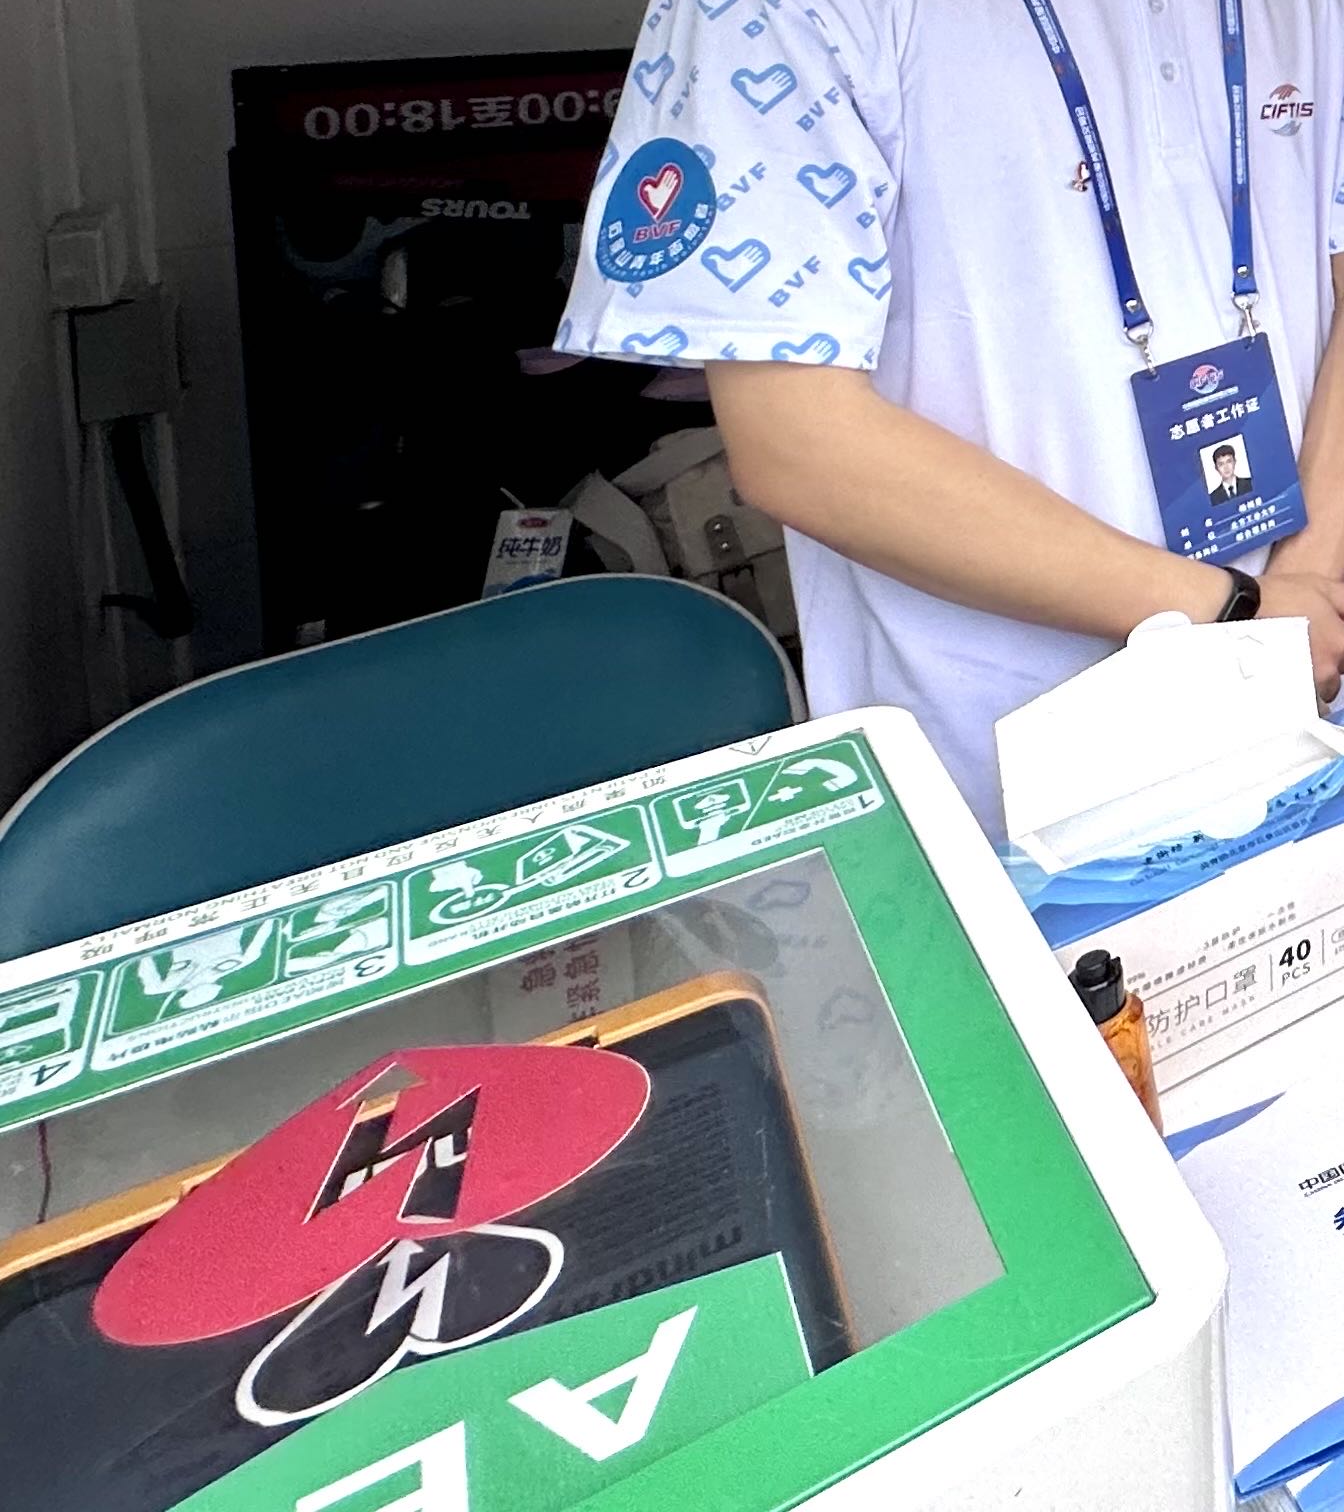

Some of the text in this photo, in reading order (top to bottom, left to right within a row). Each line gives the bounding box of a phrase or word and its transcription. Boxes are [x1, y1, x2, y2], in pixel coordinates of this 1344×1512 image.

[796, 86, 841, 133] BVF
[1260, 101, 1314, 122] CIFTIS
[717, 161, 769, 212] BVF
[420, 198, 531, 220] TOURS
[632, 219, 683, 244] BVF
[768, 255, 823, 308] BVF
[1169, 397, 1261, 441] 志愿者工作证
[496, 535, 563, 558] 纯牛奶
[858, 794, 876, 810] 1
[622, 867, 649, 889] 2
[1278, 937, 1313, 969] 40
[353, 954, 386, 978] 3
[1281, 961, 1312, 987] PCS
[30, 1060, 72, 1087] 4
